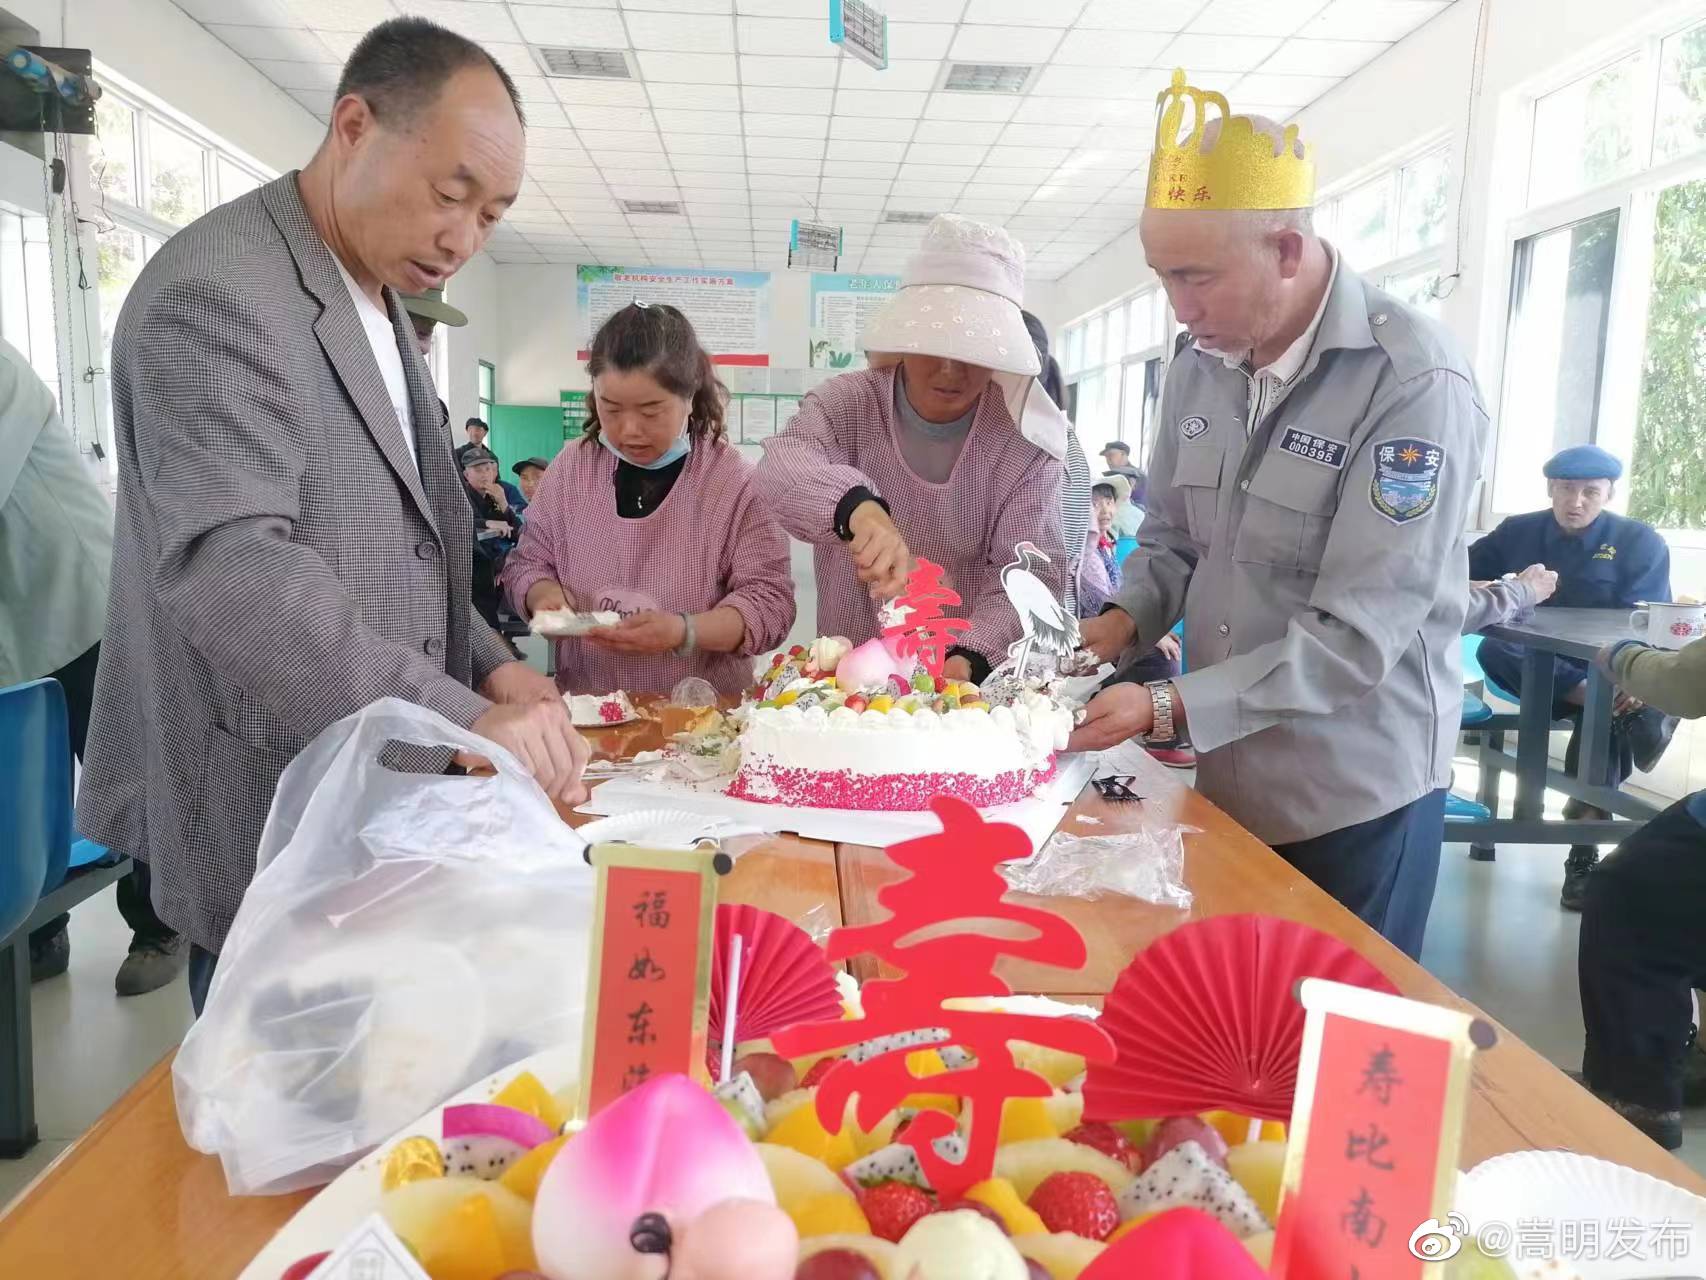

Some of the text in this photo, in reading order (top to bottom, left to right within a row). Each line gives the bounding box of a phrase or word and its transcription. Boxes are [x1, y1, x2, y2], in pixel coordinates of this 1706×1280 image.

[1289, 441, 1333, 463] 000395
[1291, 432, 1338, 454] 中国保安
[1340, 1043, 1404, 1280] 寿比南
